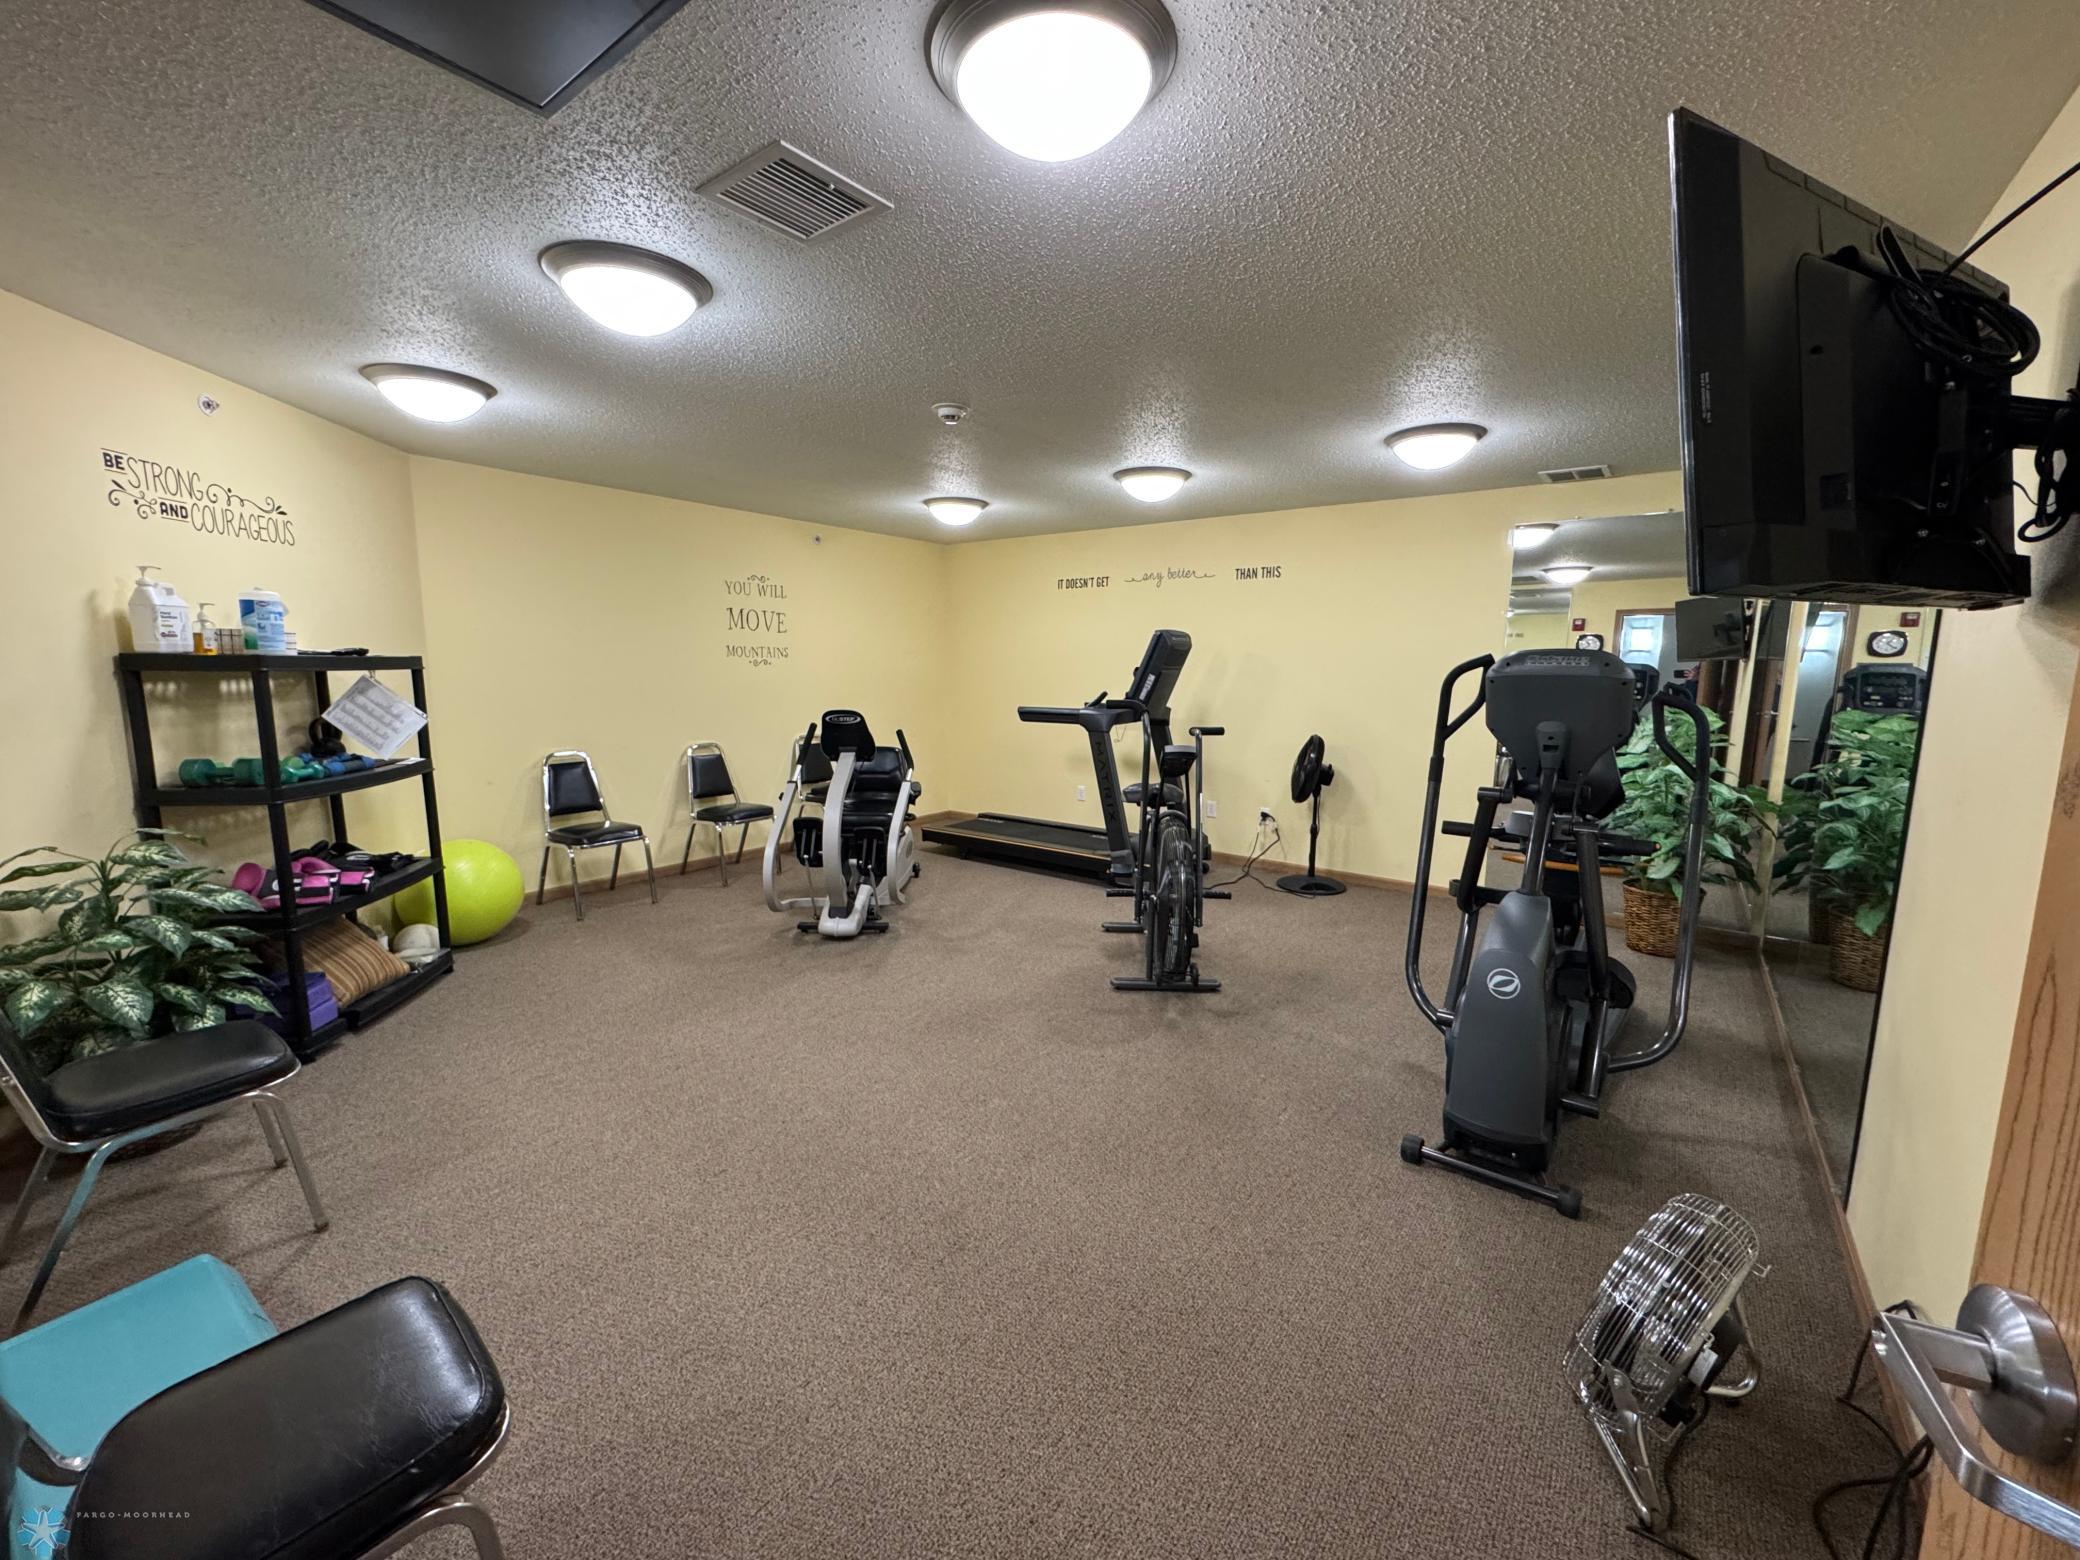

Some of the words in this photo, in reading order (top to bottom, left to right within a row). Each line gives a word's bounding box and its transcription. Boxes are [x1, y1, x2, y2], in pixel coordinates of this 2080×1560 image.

[102, 452, 125, 470] BE
[126, 456, 204, 500] STRONG
[159, 502, 189, 519] AND
[190, 503, 295, 546] COURAGEOUS
[725, 580, 751, 596] YOU
[757, 583, 787, 599] WILL
[1057, 579, 1064, 590] IT
[1065, 577, 1095, 589] DOESN'T
[1096, 576, 1110, 588] GET
[1142, 572, 1164, 588] any
[1166, 567, 1196, 580] better
[1235, 567, 1258, 580] THAN
[1261, 565, 1282, 579] THIS
[726, 607, 788, 634] MOVE
[726, 644, 789, 659] MOUNTAINS
